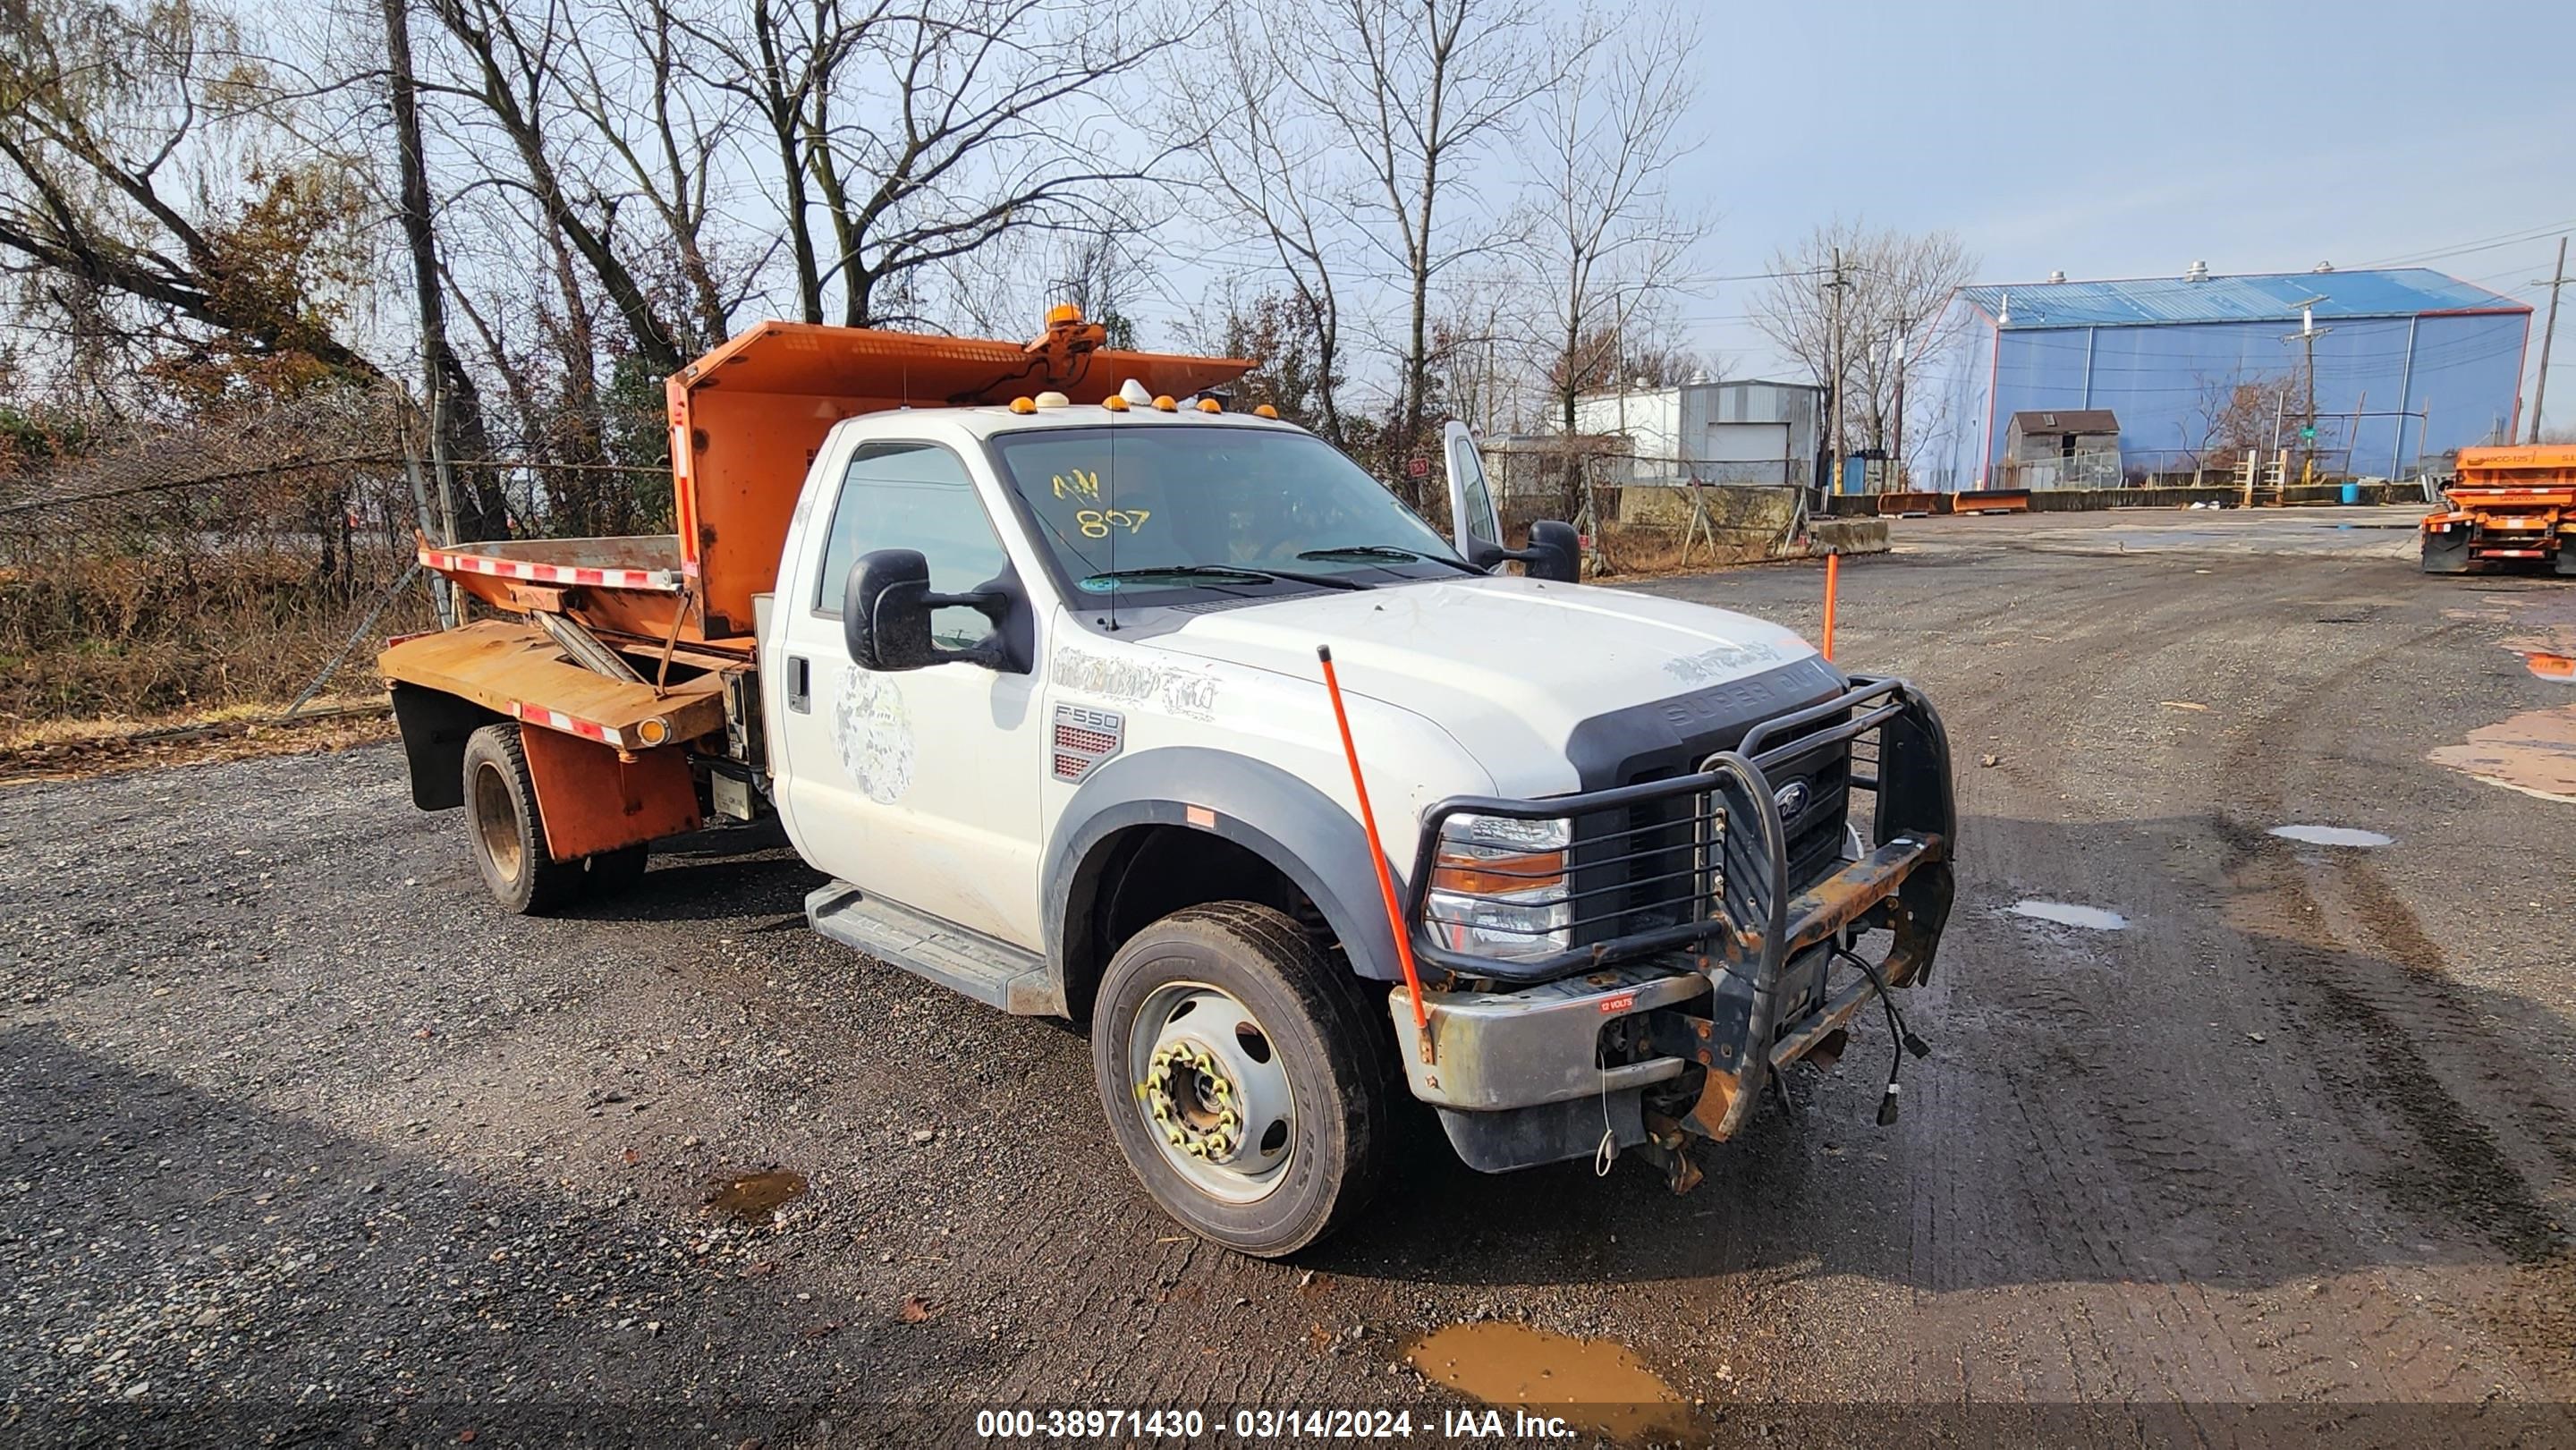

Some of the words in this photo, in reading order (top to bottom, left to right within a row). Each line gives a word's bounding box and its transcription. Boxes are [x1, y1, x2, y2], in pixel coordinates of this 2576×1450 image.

[1076, 509, 1150, 538] 807
[1660, 682, 1775, 726] SUPER
[1601, 1002, 1610, 1011] 12
[1610, 997, 1632, 1009] VOLTS
